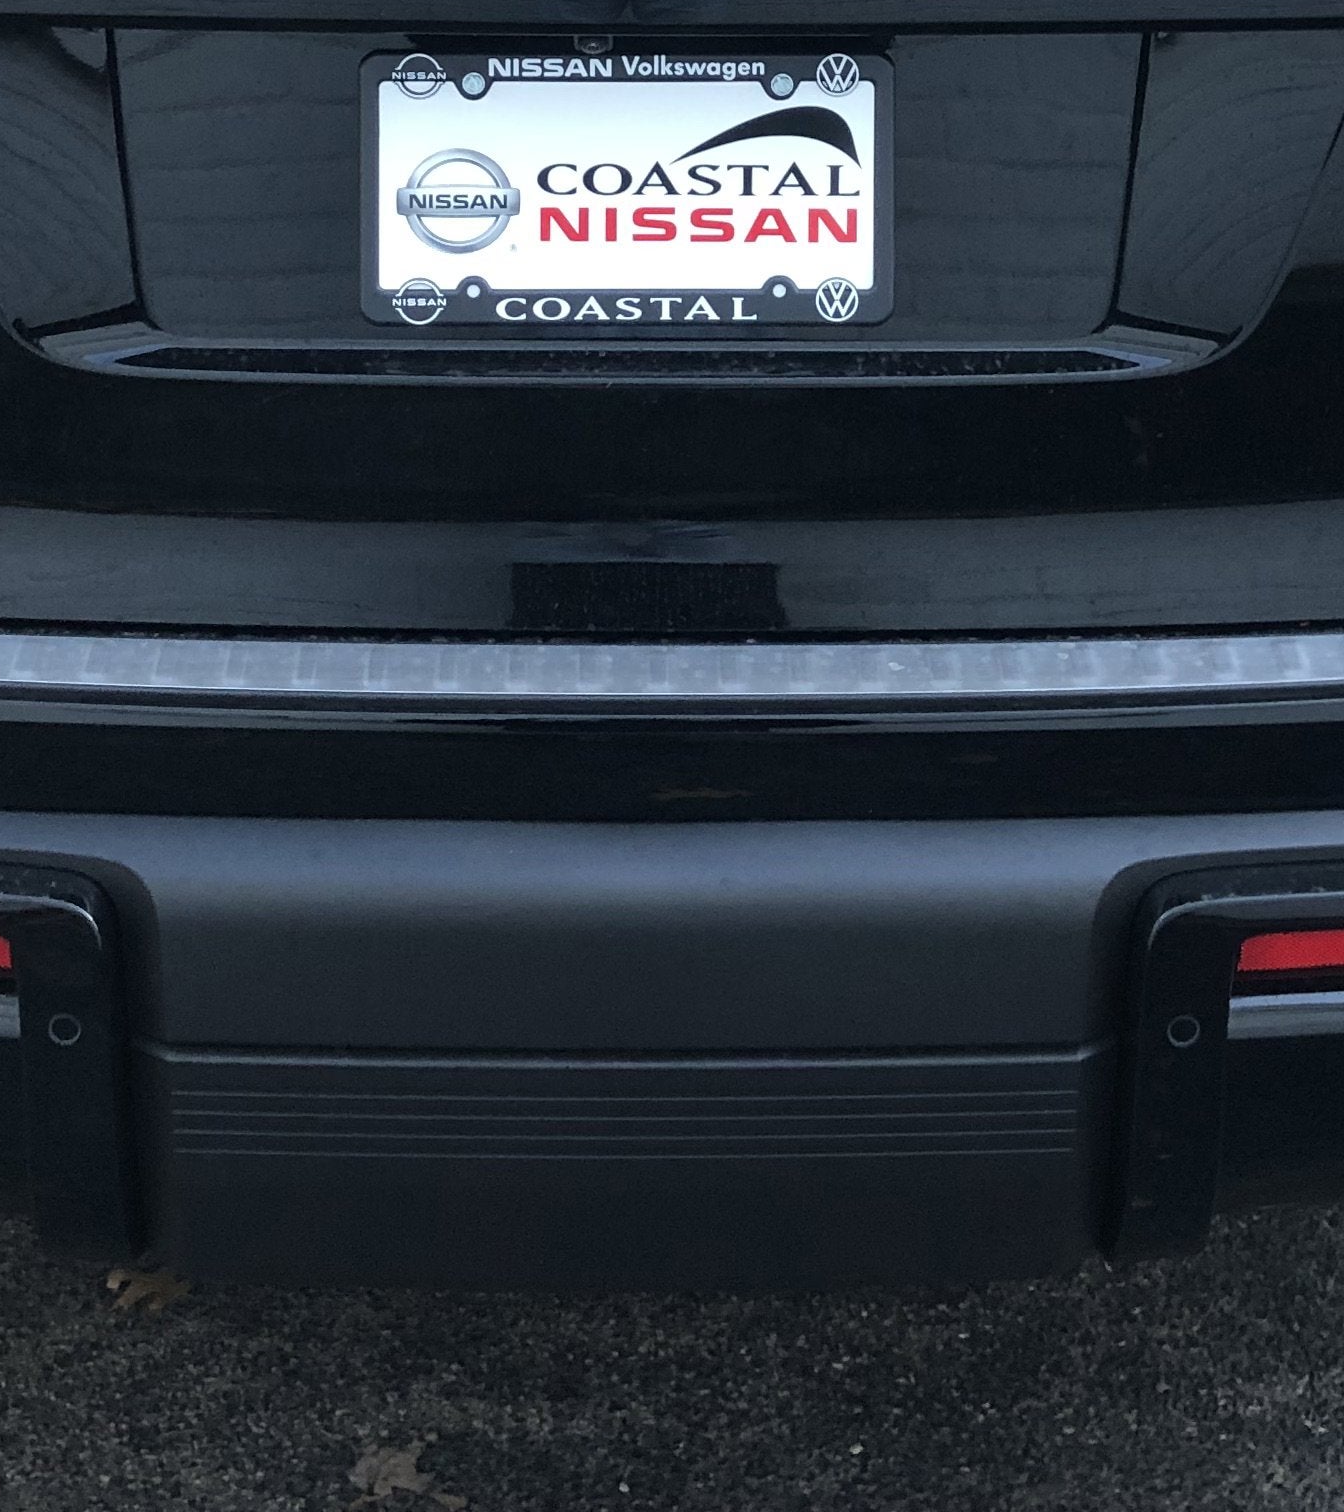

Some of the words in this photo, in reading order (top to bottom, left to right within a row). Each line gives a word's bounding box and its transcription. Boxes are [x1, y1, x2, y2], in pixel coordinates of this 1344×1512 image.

[391, 71, 447, 80] NISSAN
[488, 58, 612, 78] NISSAN
[621, 54, 765, 81] Volkswagen
[537, 162, 861, 197] COASTAL
[408, 191, 508, 210] NISSAN
[540, 207, 857, 243] NISSAN
[391, 297, 447, 307] NISSAN
[495, 296, 757, 321] COASTAL
